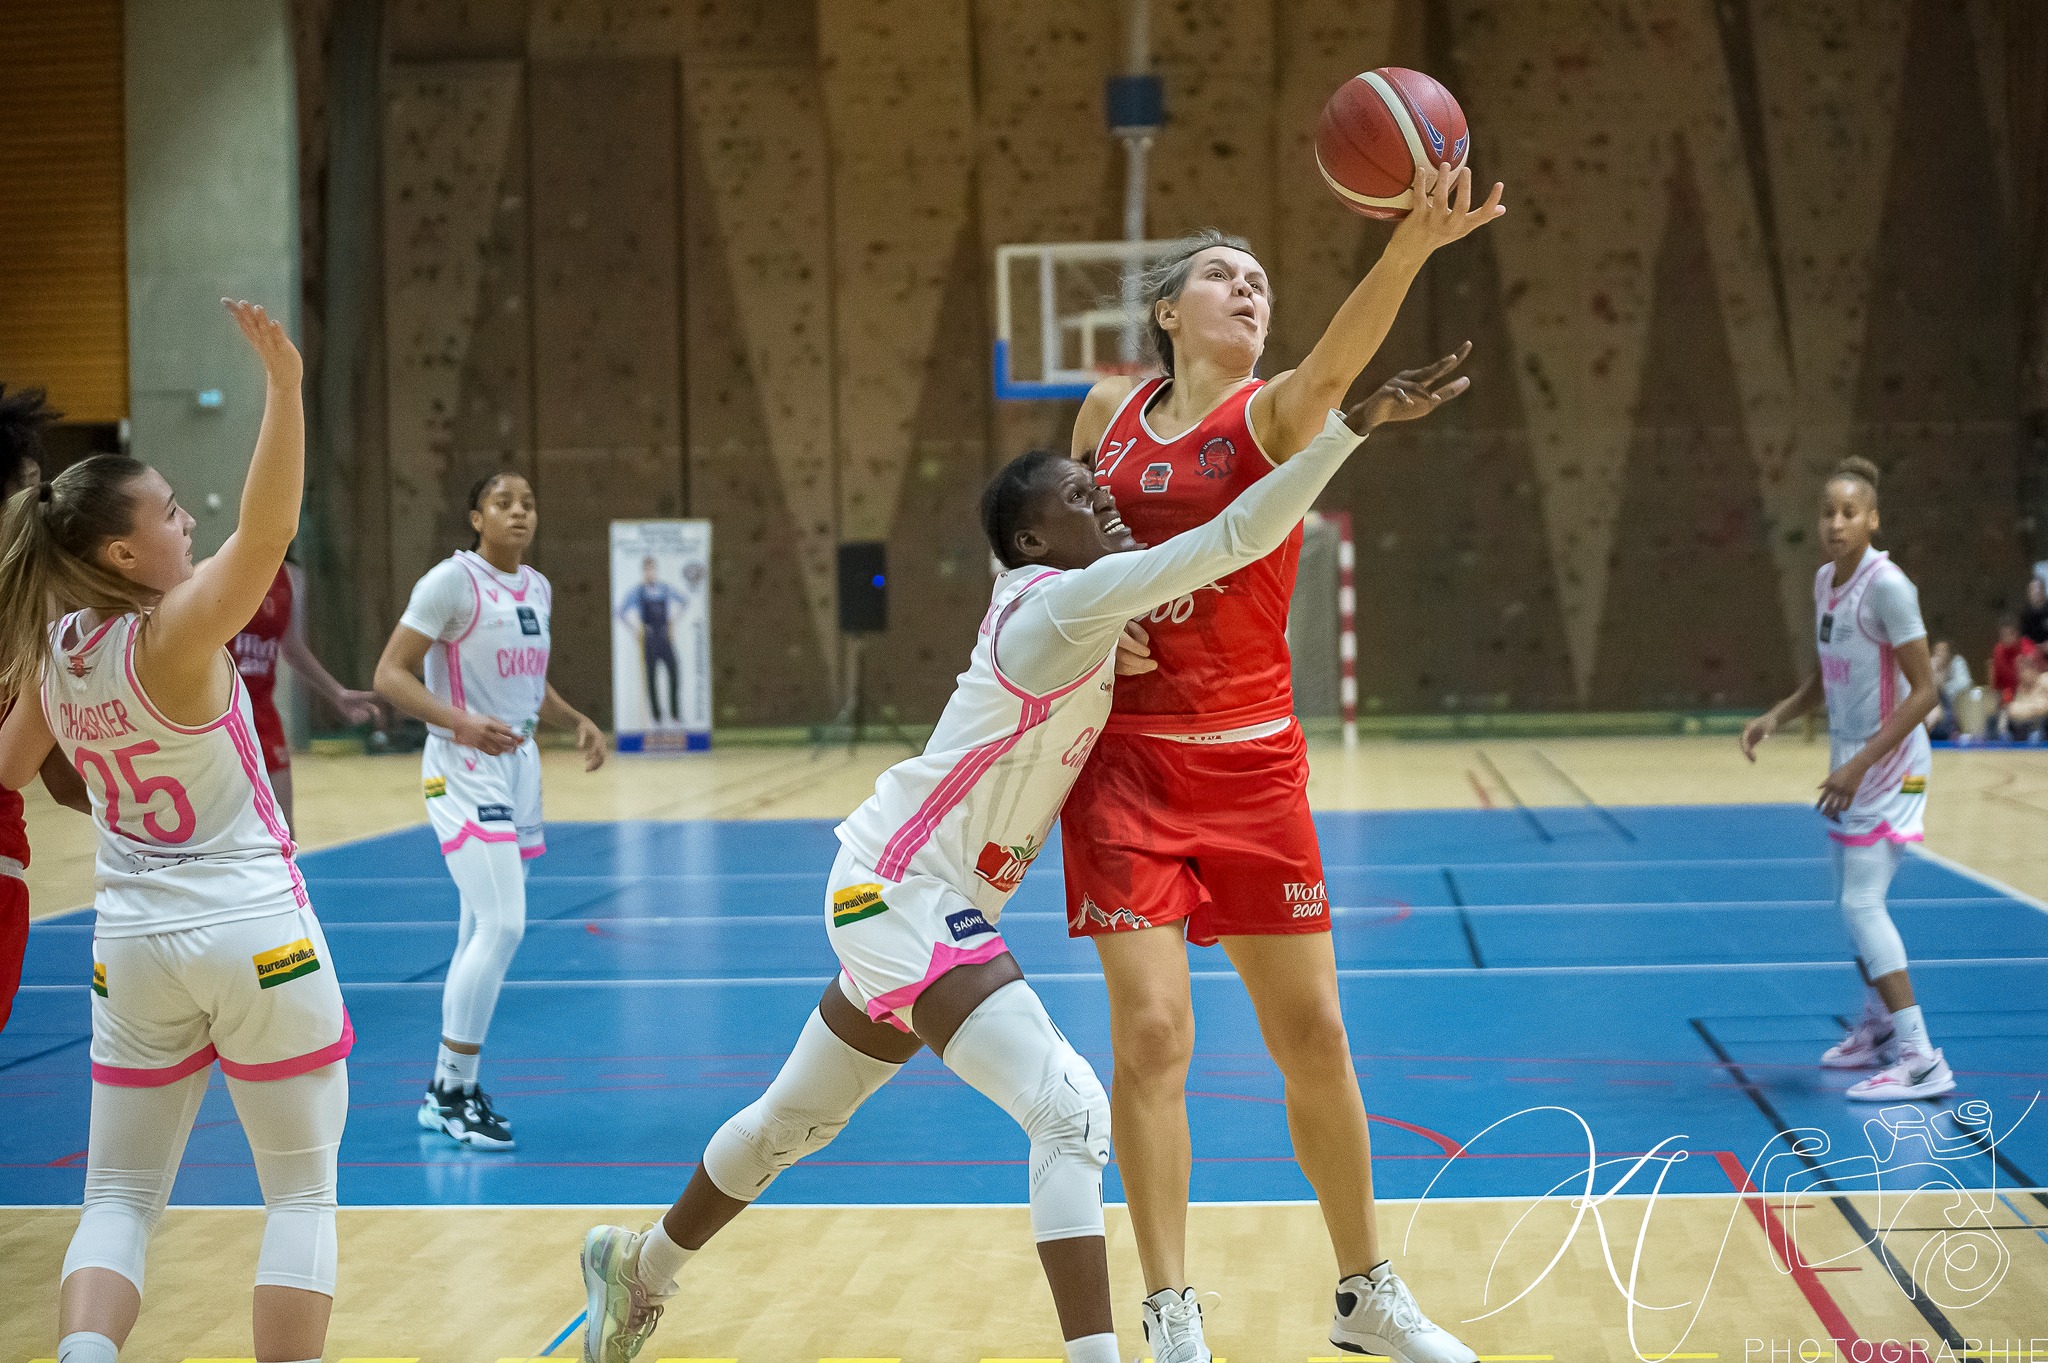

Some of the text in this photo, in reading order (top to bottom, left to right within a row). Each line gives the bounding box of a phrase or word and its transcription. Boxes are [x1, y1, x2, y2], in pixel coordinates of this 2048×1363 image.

[60, 699, 138, 740] CHABRIER
[1283, 879, 1327, 901] Work
[1292, 902, 1323, 918] 2000
